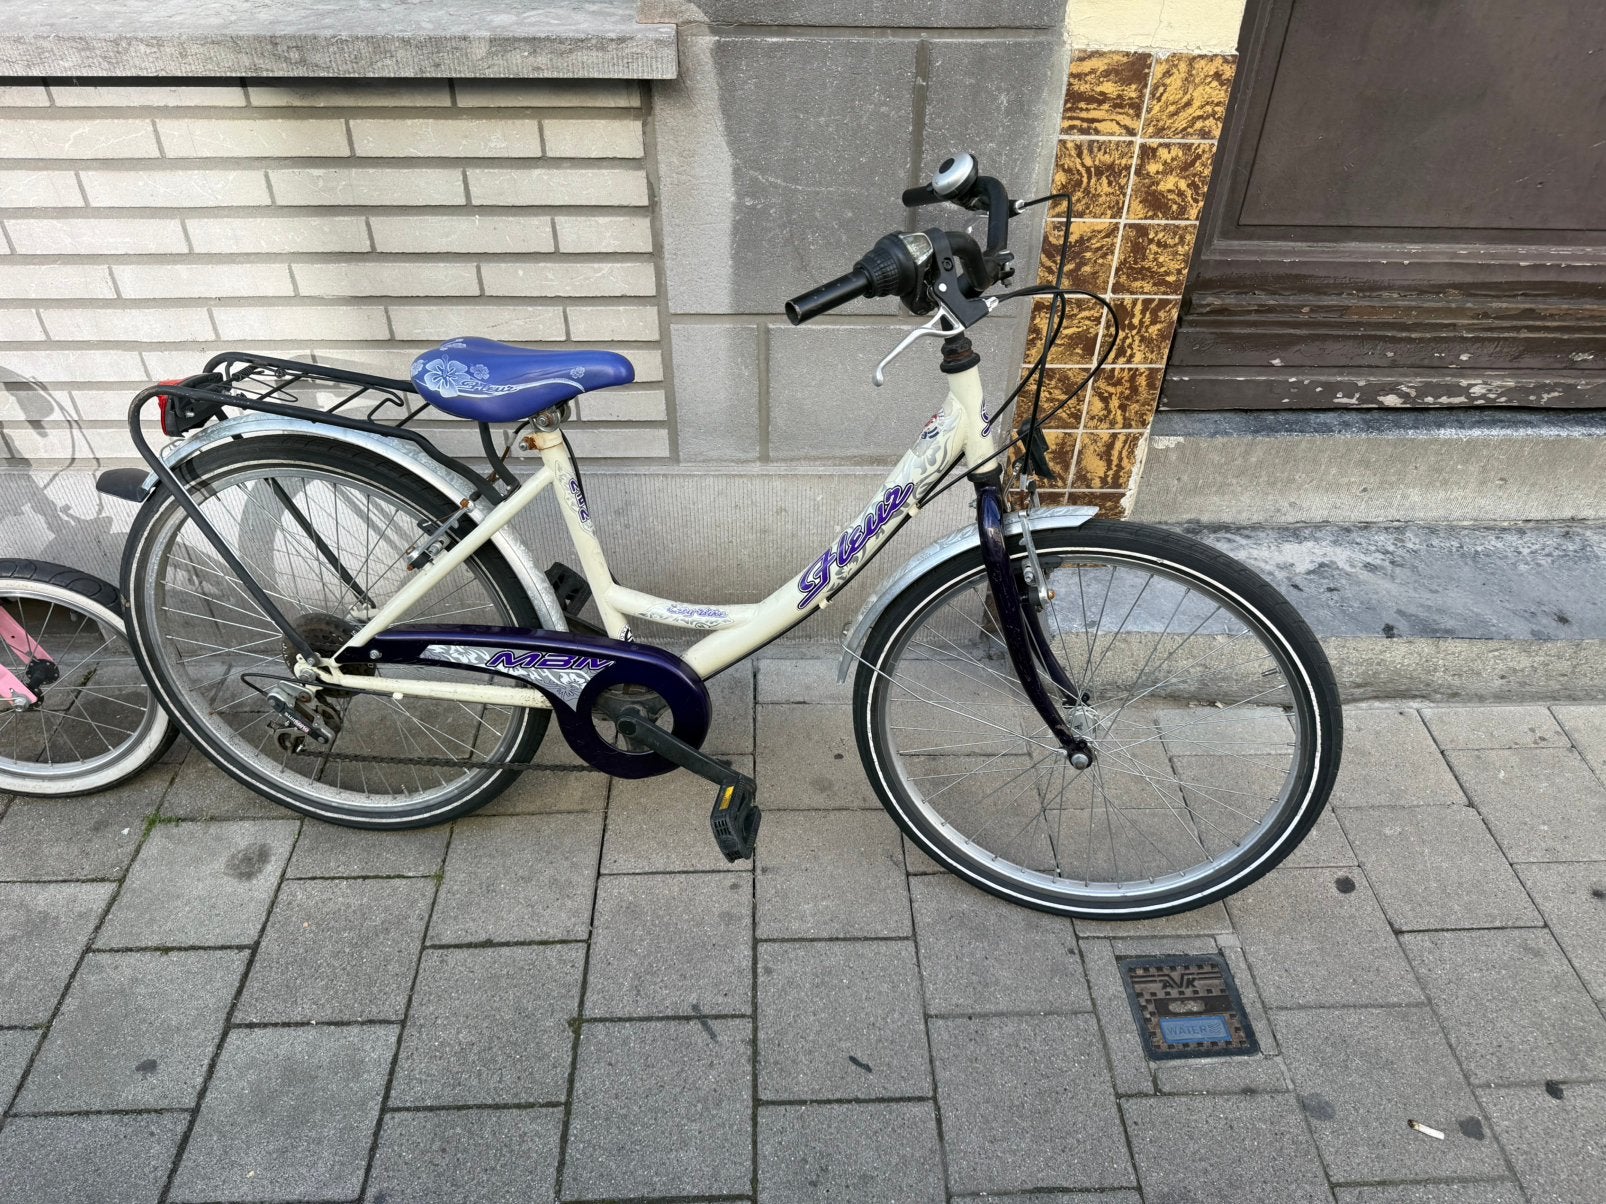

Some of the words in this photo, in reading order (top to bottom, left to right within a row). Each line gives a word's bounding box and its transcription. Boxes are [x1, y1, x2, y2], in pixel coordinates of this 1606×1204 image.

[798, 482, 914, 609] Fleur
[1161, 972, 1197, 990] AVK
[1166, 1024, 1208, 1036] WATER
